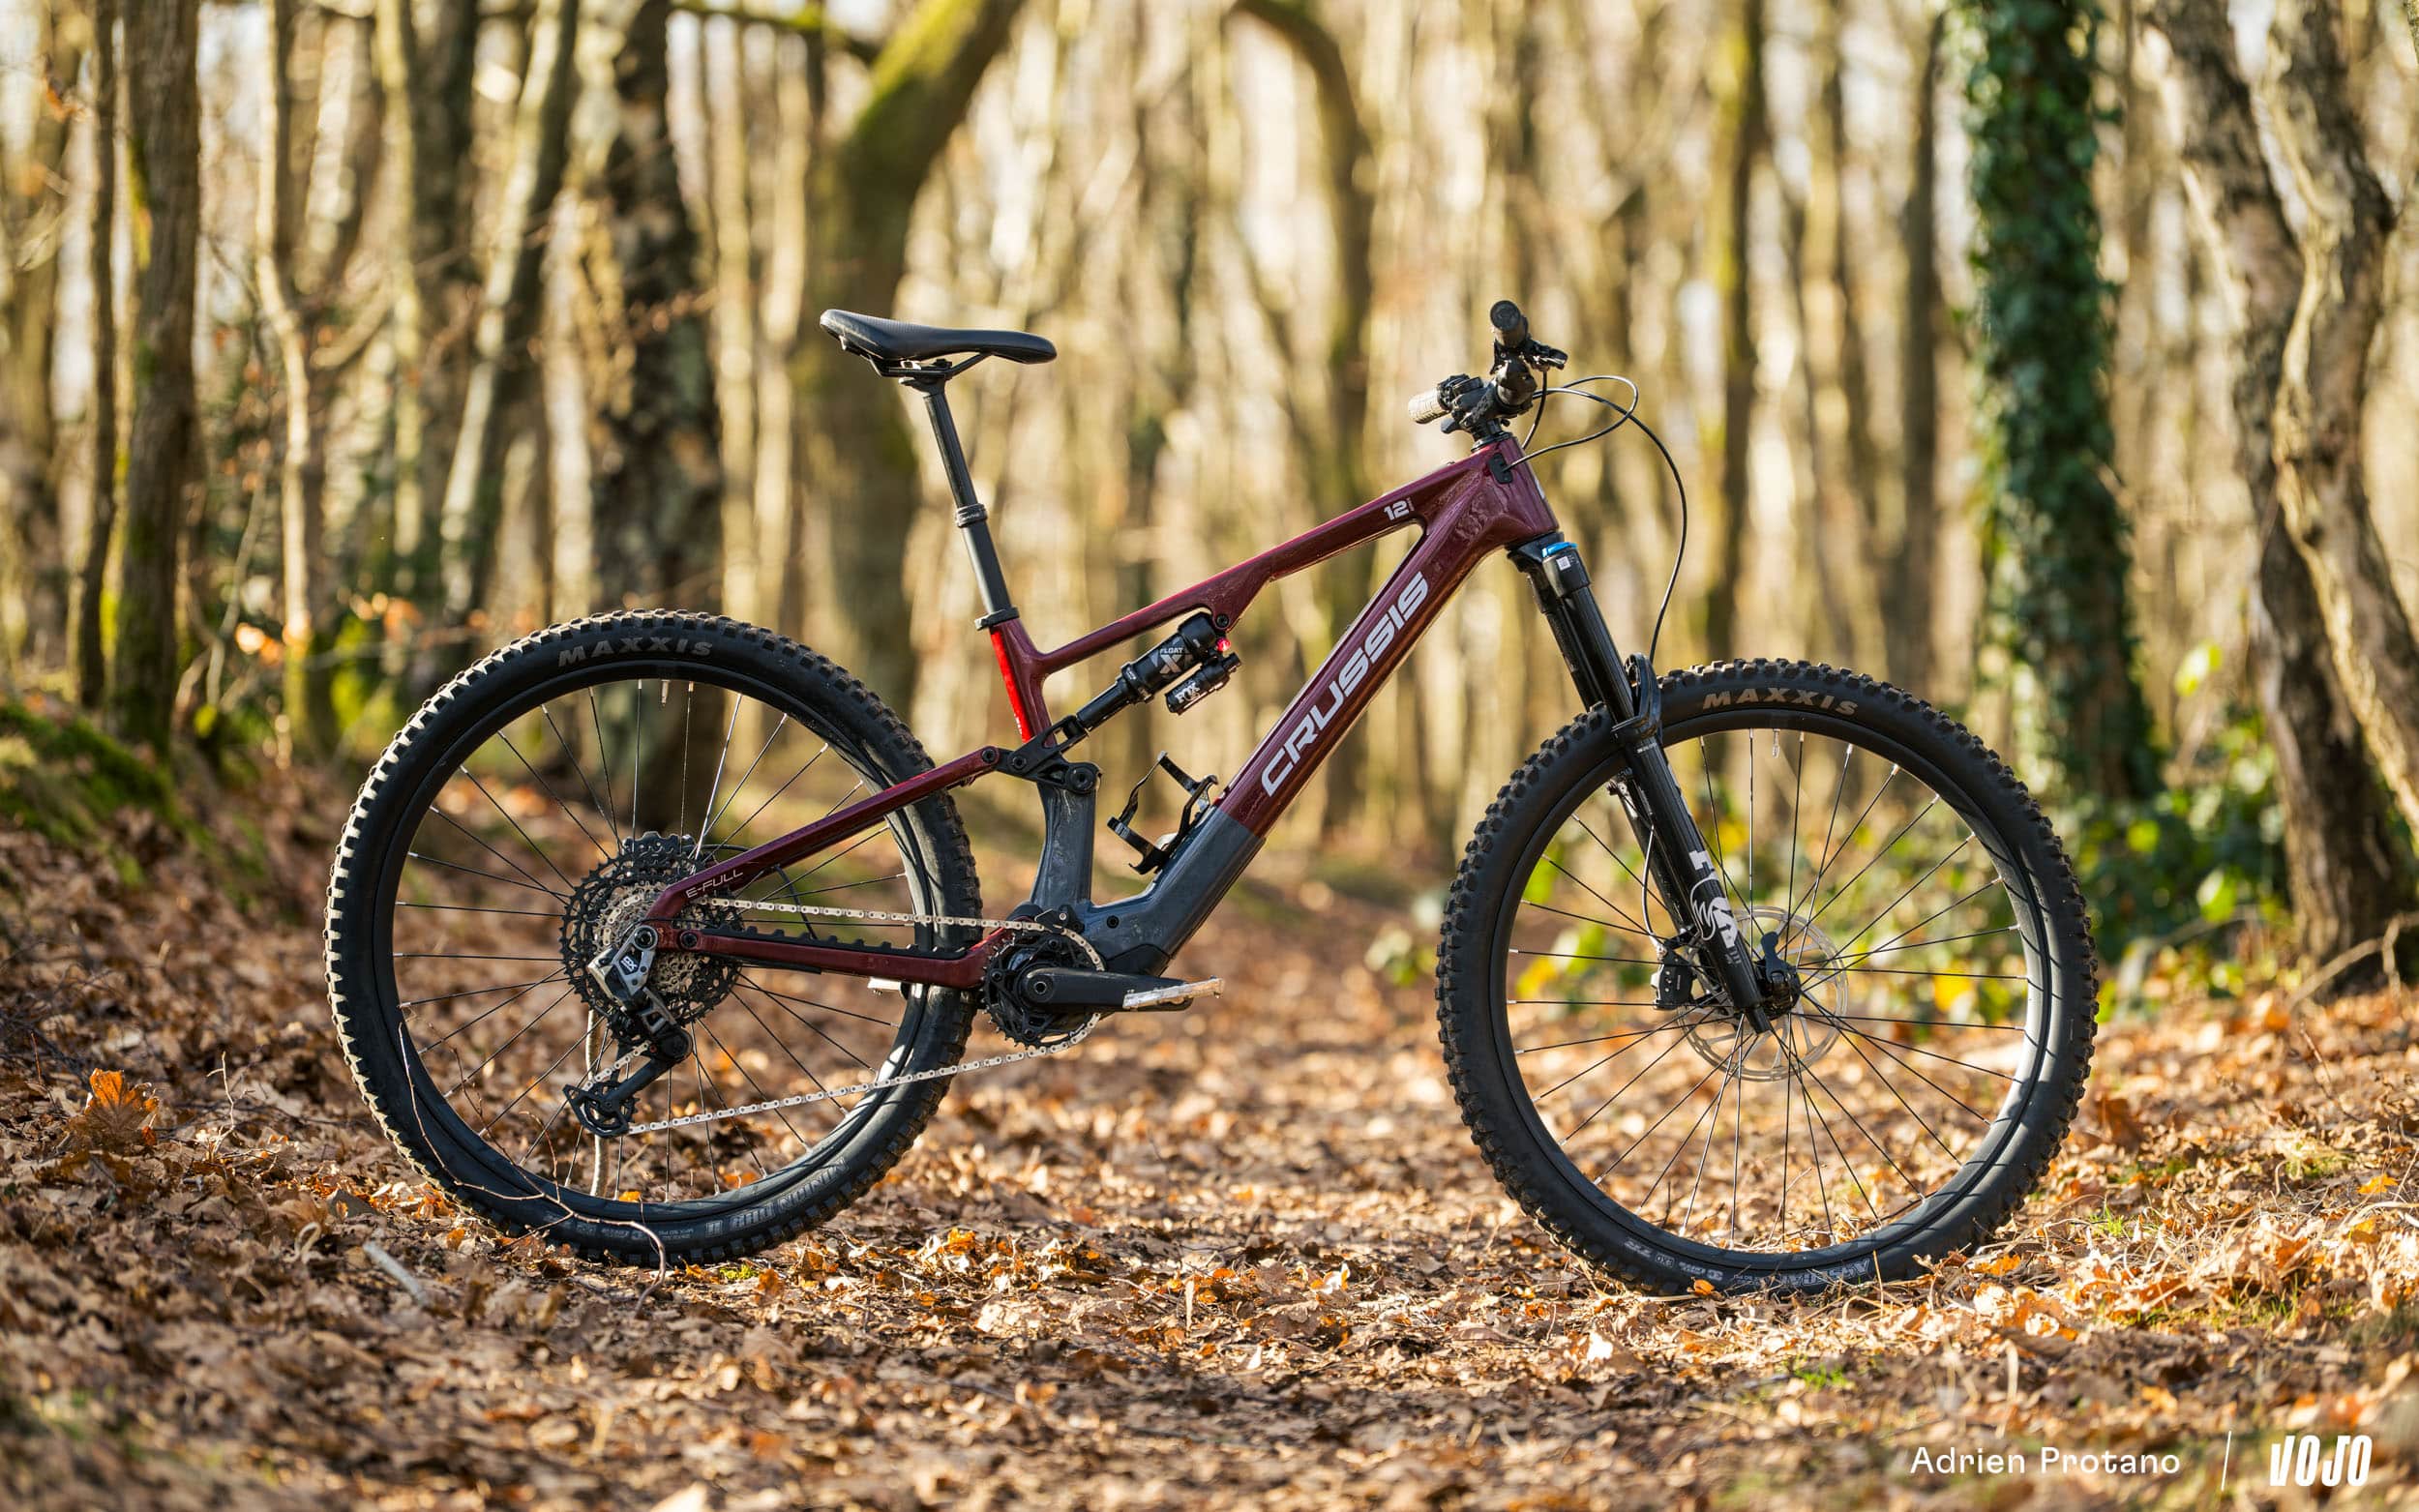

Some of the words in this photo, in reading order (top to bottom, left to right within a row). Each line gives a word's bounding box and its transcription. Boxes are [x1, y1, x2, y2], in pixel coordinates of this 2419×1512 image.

[1384, 500, 1410, 520] 12
[558, 637, 713, 667] MAXXIS
[1261, 571, 1429, 797] CRUSSIS
[1702, 688, 1859, 716] MAXXIS
[685, 869, 743, 898] E-FULL
